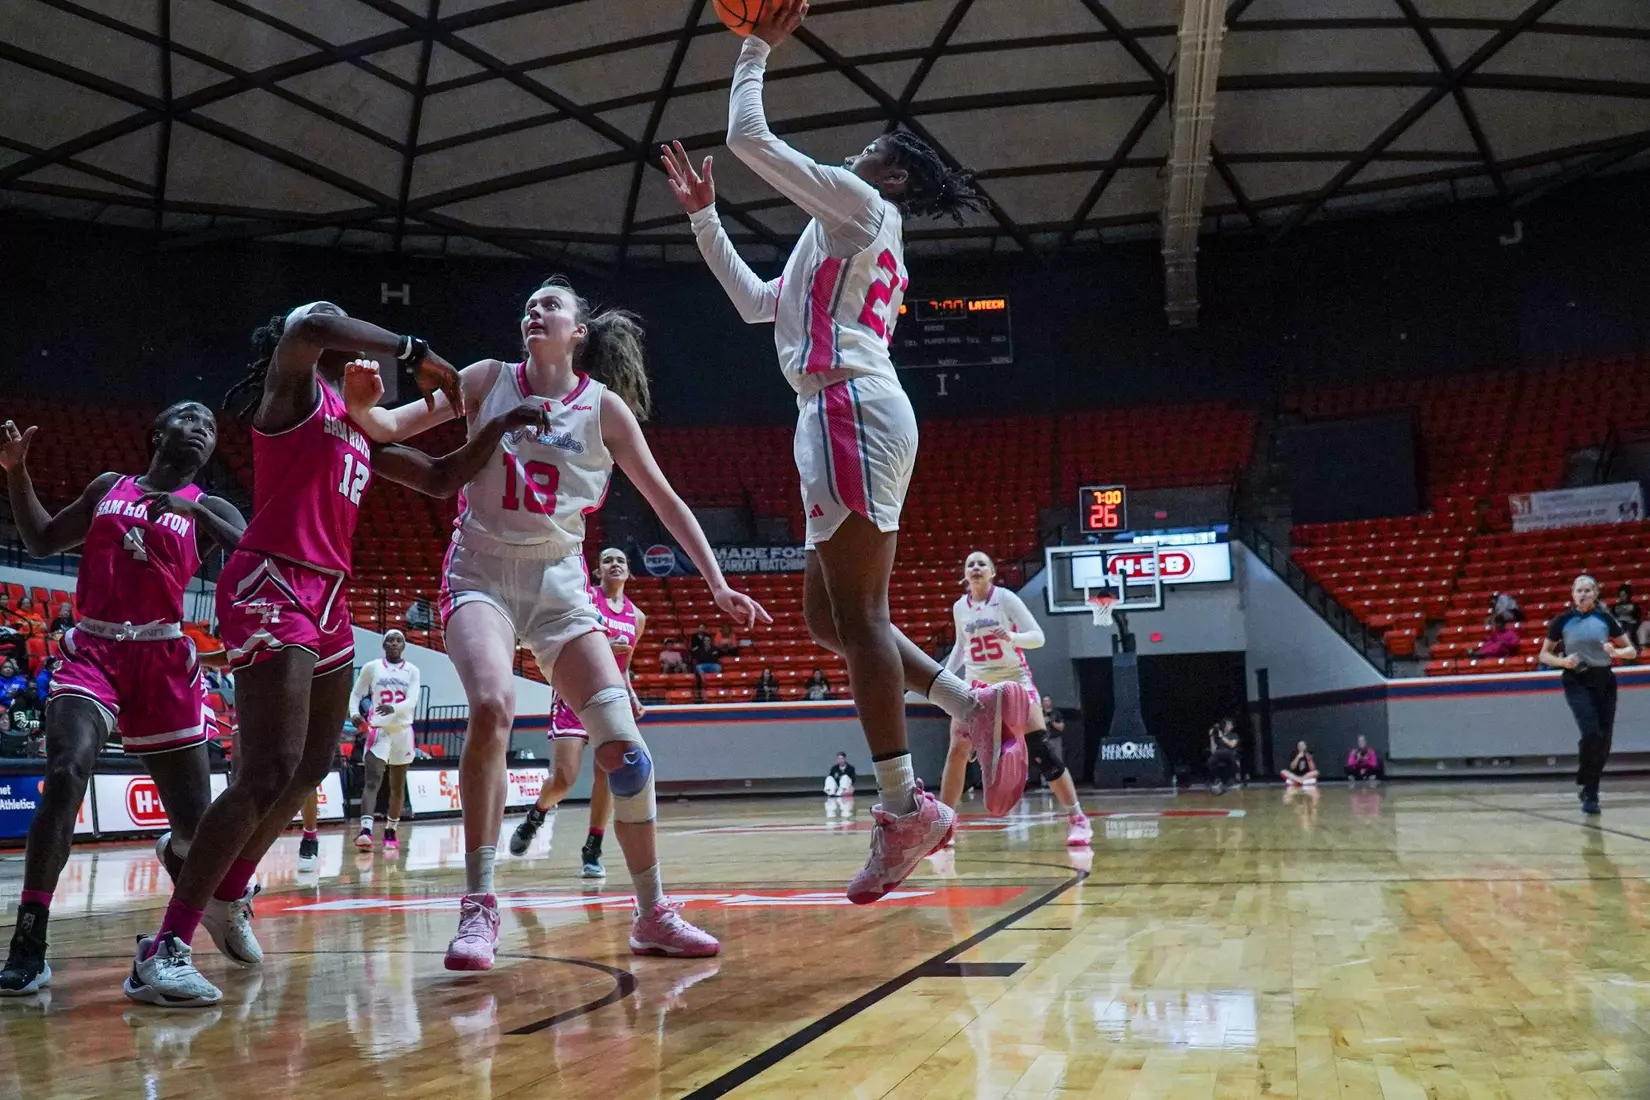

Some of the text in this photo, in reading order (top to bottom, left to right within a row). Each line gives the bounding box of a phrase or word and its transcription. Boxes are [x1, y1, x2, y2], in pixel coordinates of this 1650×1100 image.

[1499, 221, 1523, 245] J
[381, 282, 410, 305] H
[936, 373, 948, 396] I
[324, 413, 348, 442] SAM
[338, 453, 370, 508] 12
[502, 452, 560, 517] 18
[96, 500, 125, 517] SAM
[1093, 490, 1122, 504] 7:00
[1090, 505, 1118, 528] 26
[123, 526, 149, 562] 4
[712, 547, 767, 560] MADE
[970, 634, 1004, 662] 25
[0, 798, 36, 811] Athletics
